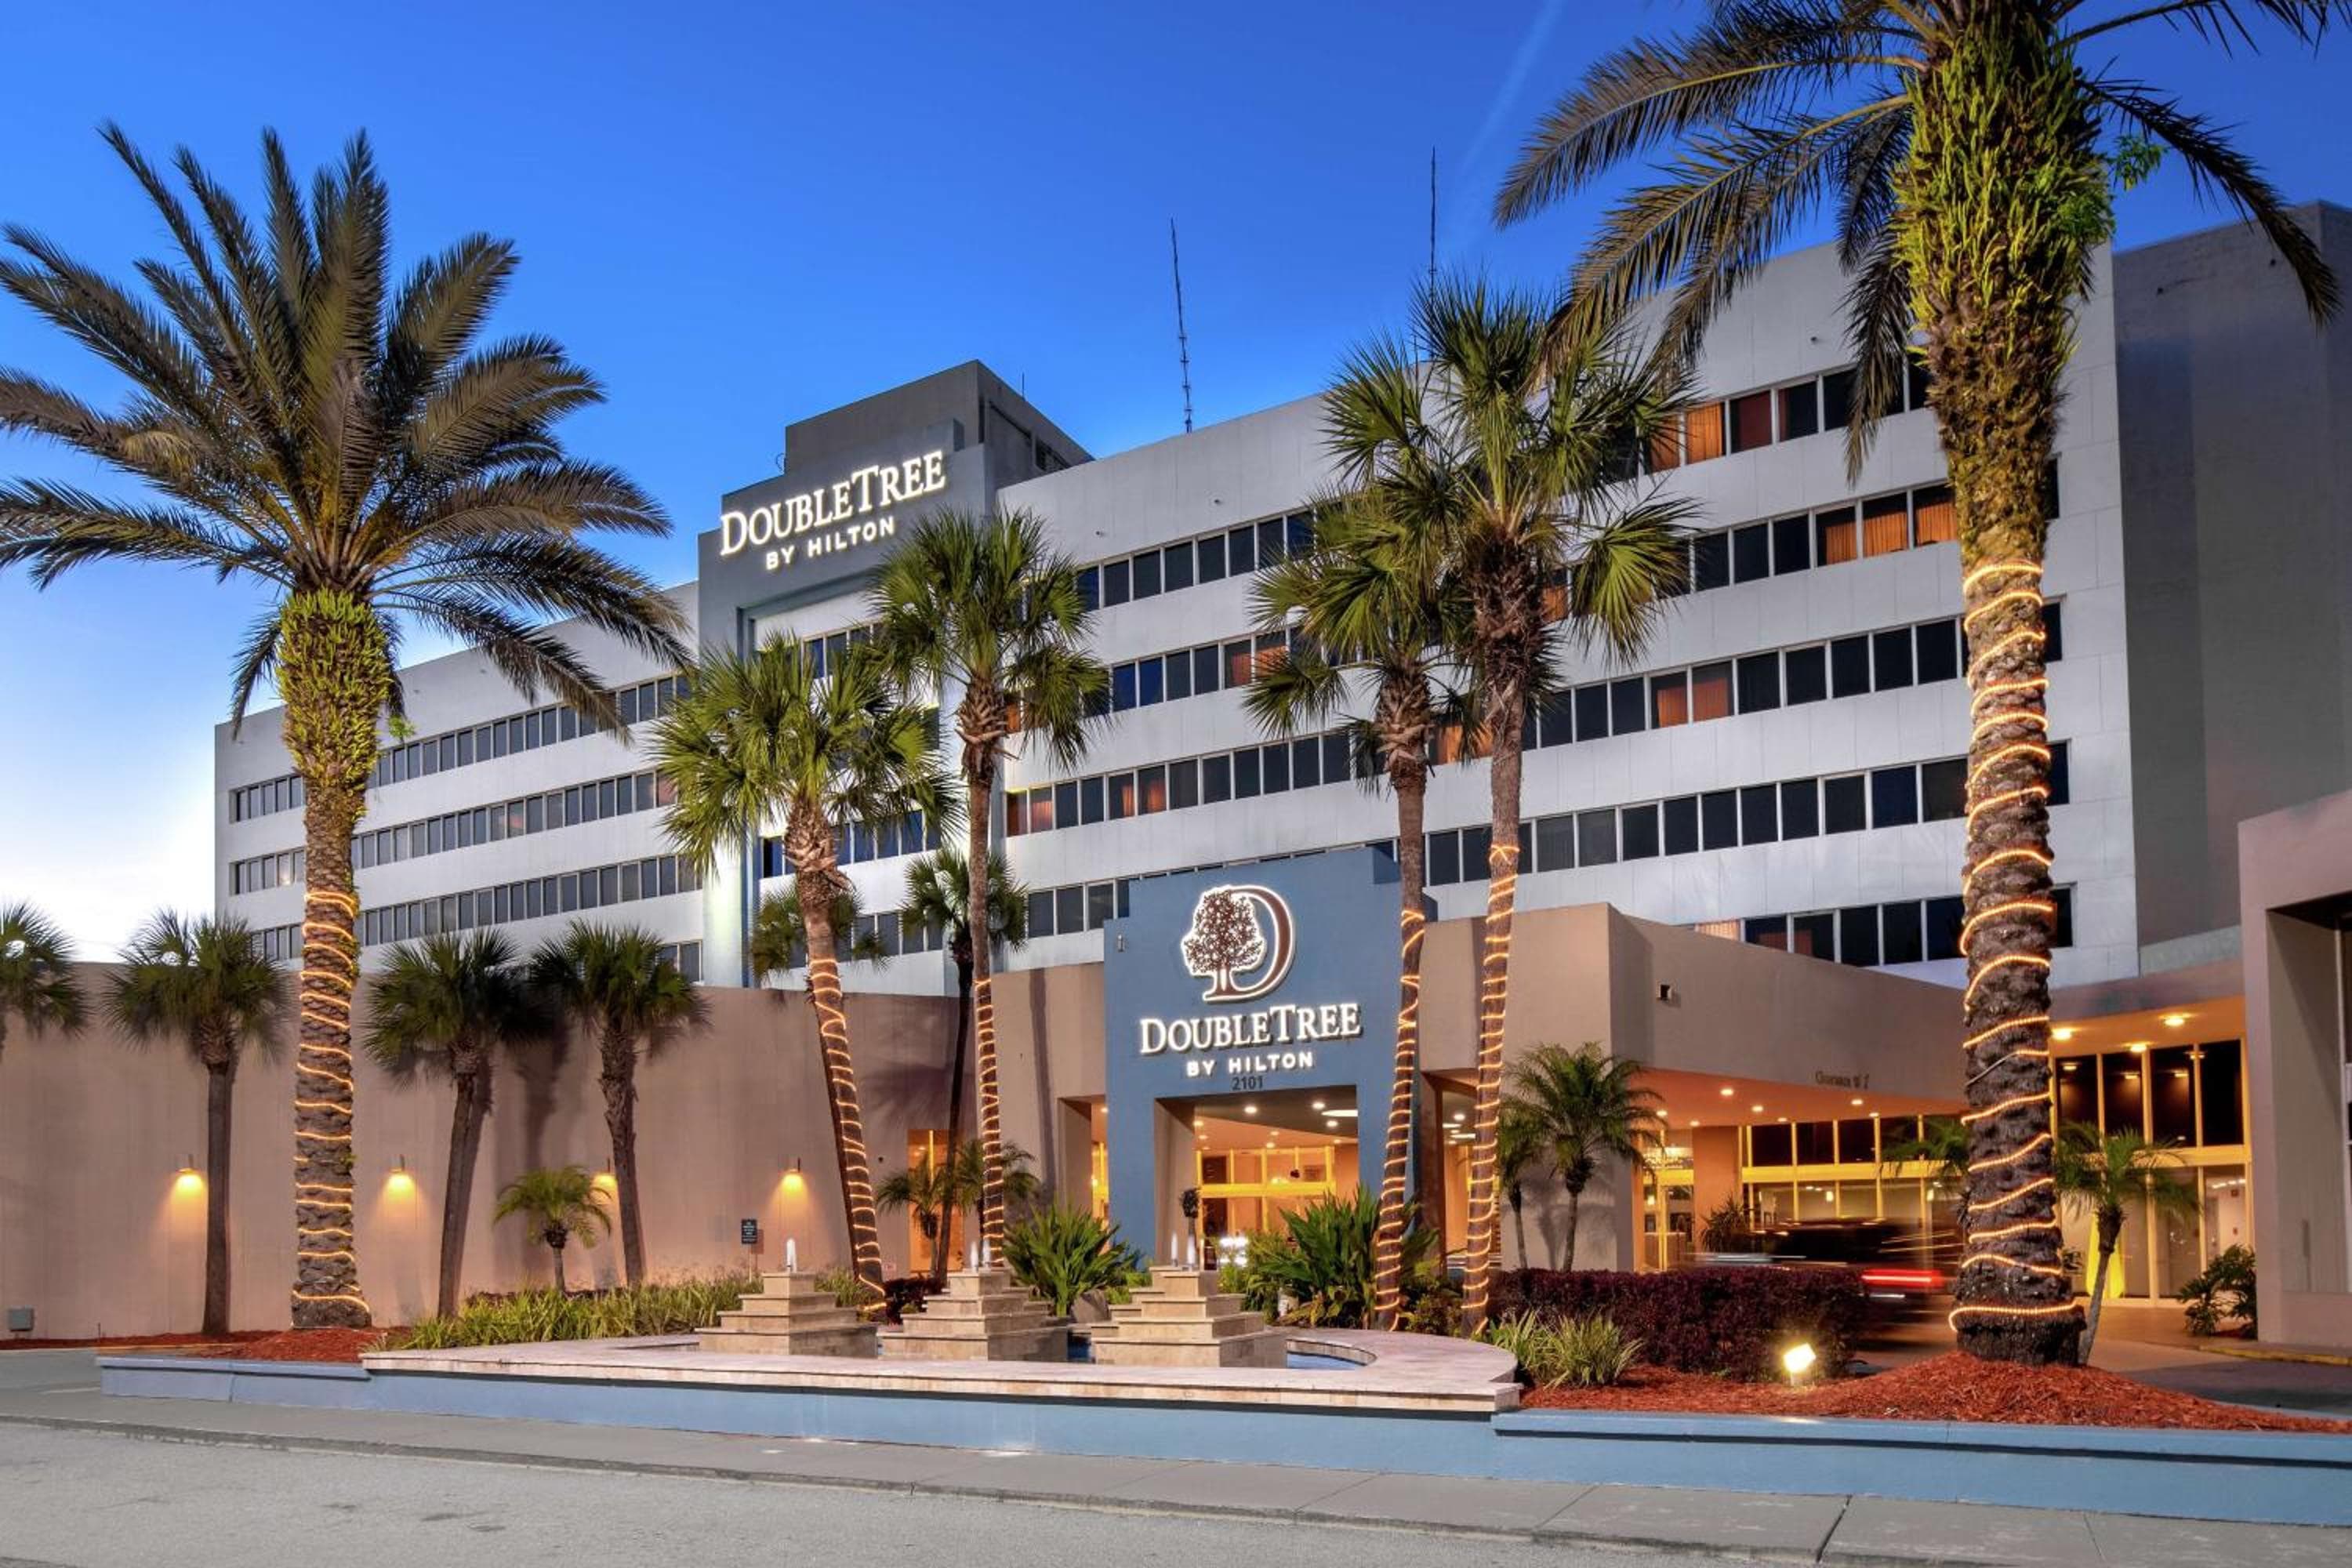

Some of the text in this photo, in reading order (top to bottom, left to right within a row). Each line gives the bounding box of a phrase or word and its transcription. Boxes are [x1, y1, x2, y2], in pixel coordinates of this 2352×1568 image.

[720, 450, 946, 556] DOUBLETREE
[765, 516, 895, 571] BY HILTON
[1140, 1003, 1362, 1054] DOUBLETREE
[1186, 1051, 1314, 1076] BY HILTON
[1232, 1075, 1264, 1091] 2101
